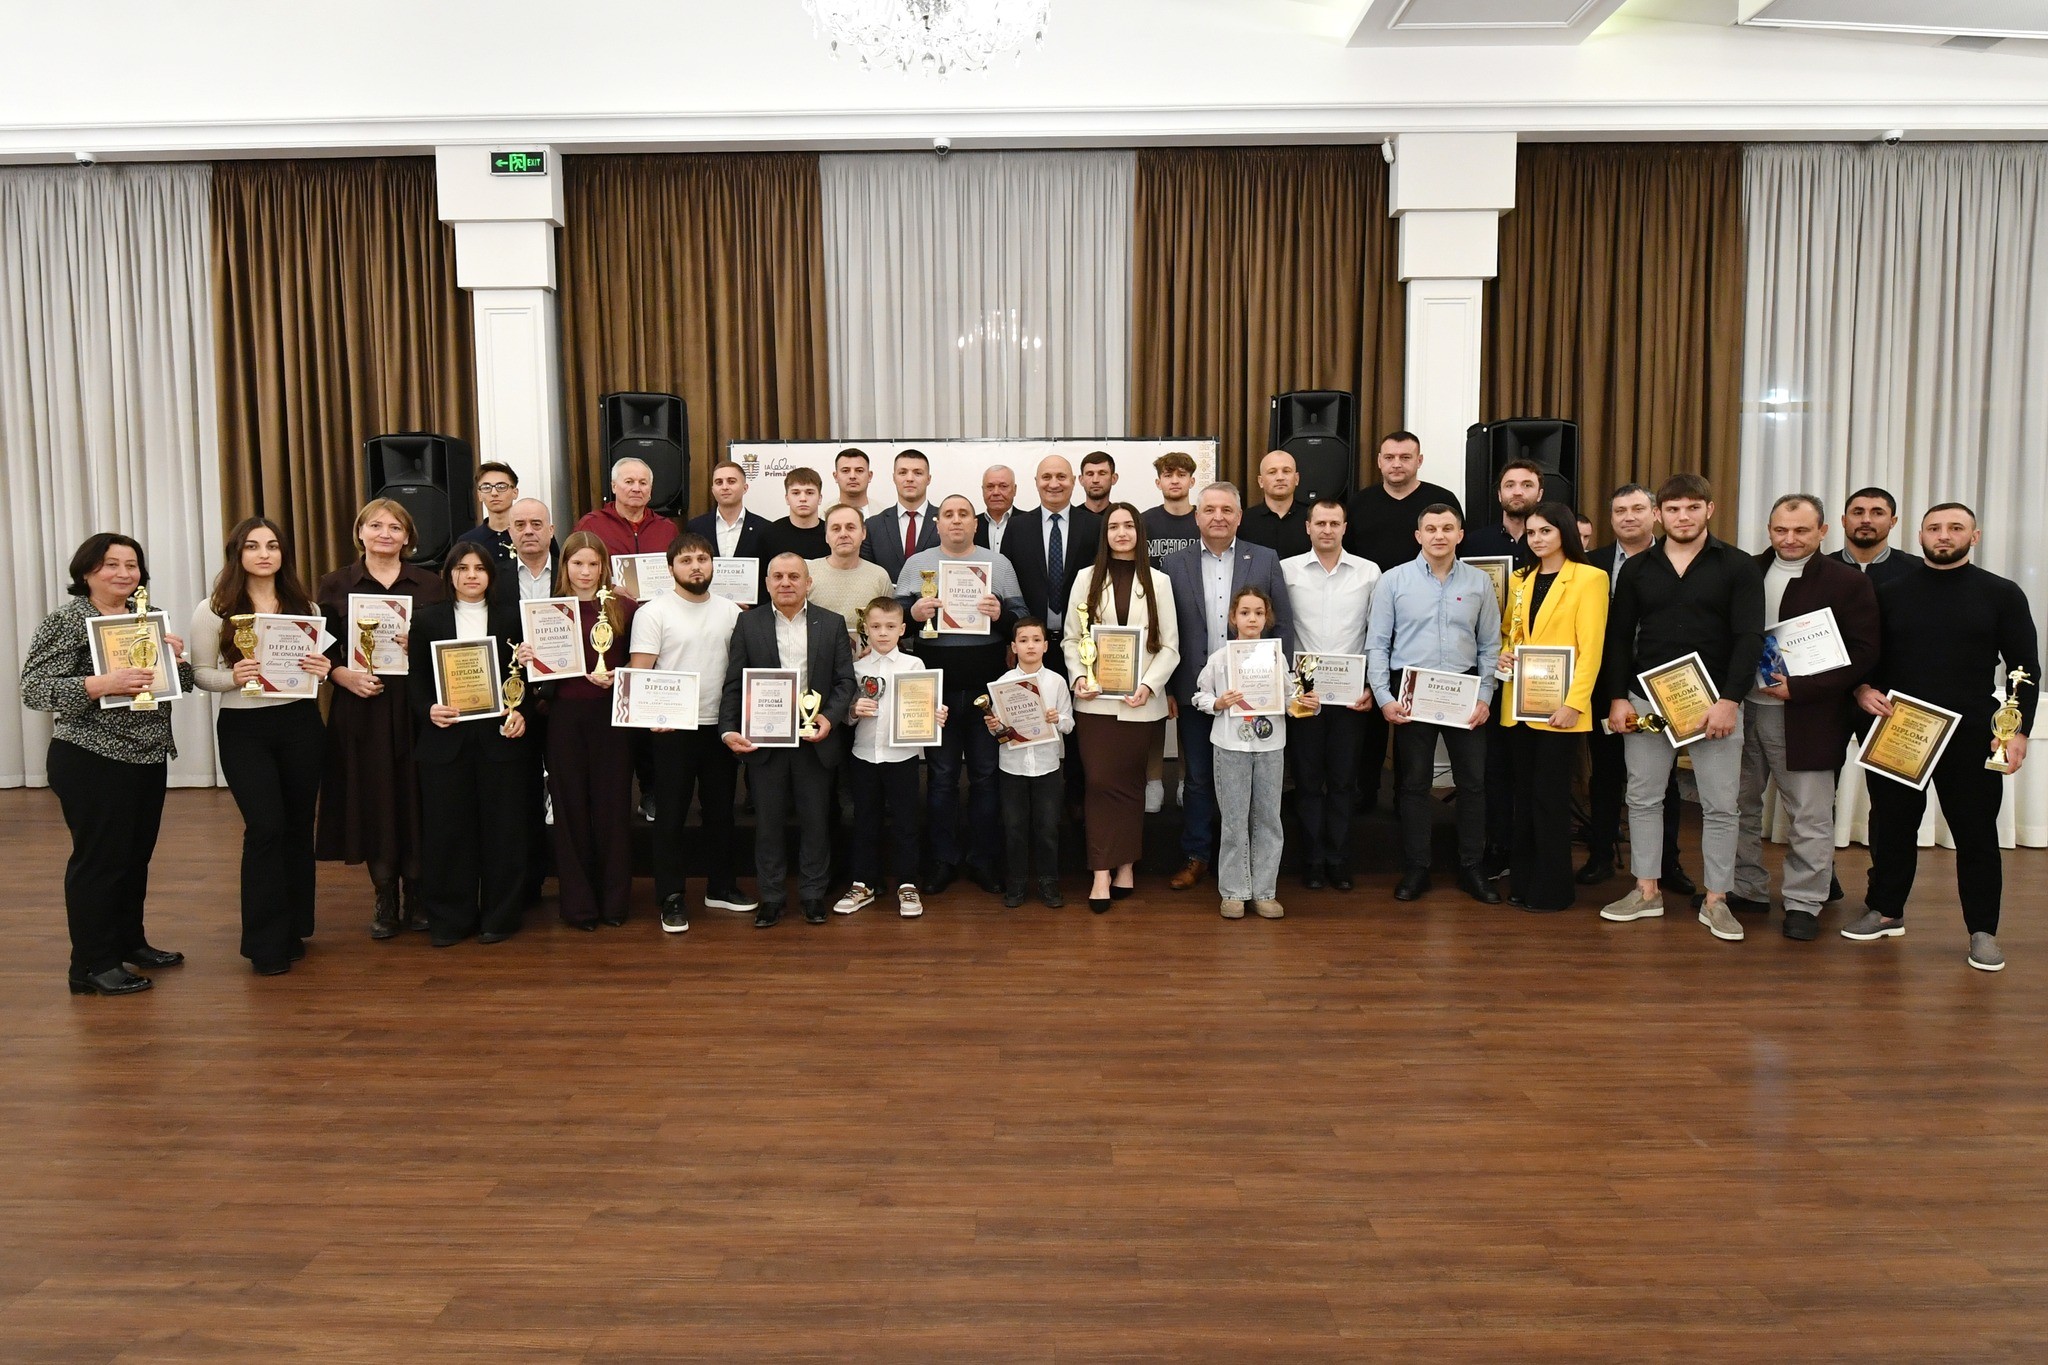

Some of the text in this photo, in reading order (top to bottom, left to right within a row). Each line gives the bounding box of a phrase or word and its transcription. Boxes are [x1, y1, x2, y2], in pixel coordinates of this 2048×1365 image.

[527, 158, 541, 167] EXIT
[535, 625, 572, 634] DIPLOMĂ
[1786, 629, 1830, 647] DIPLOMA
[451, 667, 485, 677] DIPLOMĂ
[644, 684, 681, 692] DIPLOMĂ
[1428, 683, 1462, 693] DIPLOMĂ
[1665, 685, 1700, 702] DIPLOMĂ
[1005, 701, 1039, 713] DIPLOMĂ
[1891, 724, 1929, 744] DIPLOMĂ
